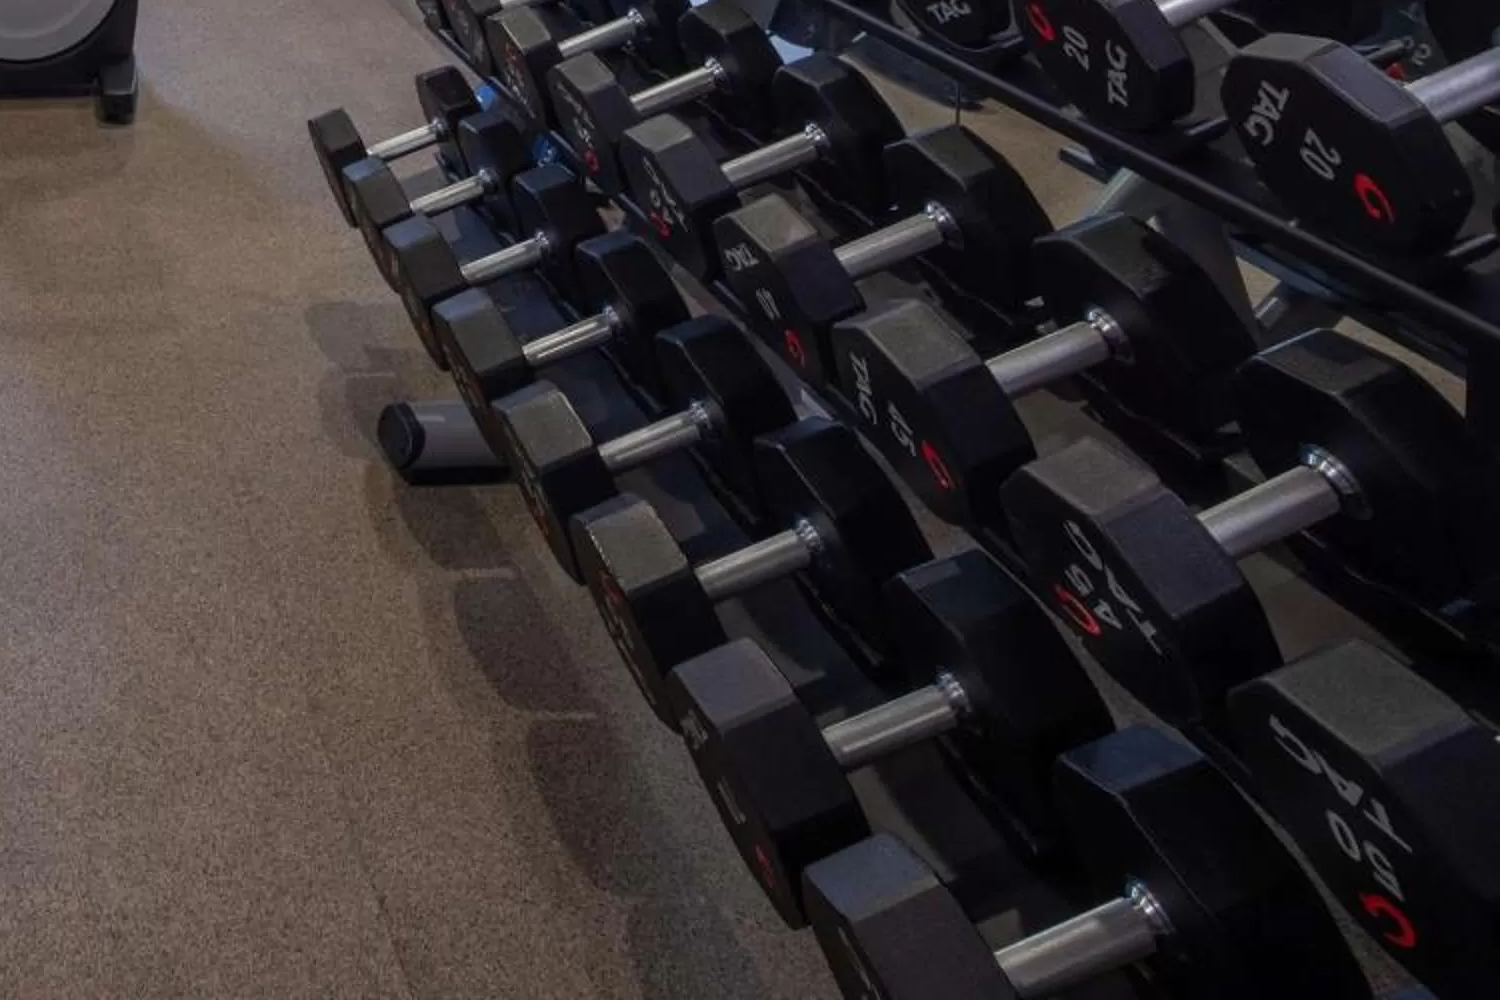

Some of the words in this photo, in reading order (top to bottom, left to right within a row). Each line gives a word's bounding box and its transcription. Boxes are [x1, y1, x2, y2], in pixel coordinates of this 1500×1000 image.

[1062, 25, 1090, 72] 20
[1105, 39, 1129, 108] TAG
[1243, 80, 1290, 147] TAG
[1300, 127, 1342, 180] 20
[724, 242, 760, 272] TAG
[850, 351, 878, 425] TAG
[1062, 518, 1164, 657] TAG
[1063, 563, 1124, 631] 45
[1269, 713, 1414, 854] TAG
[1325, 808, 1406, 902] 50
